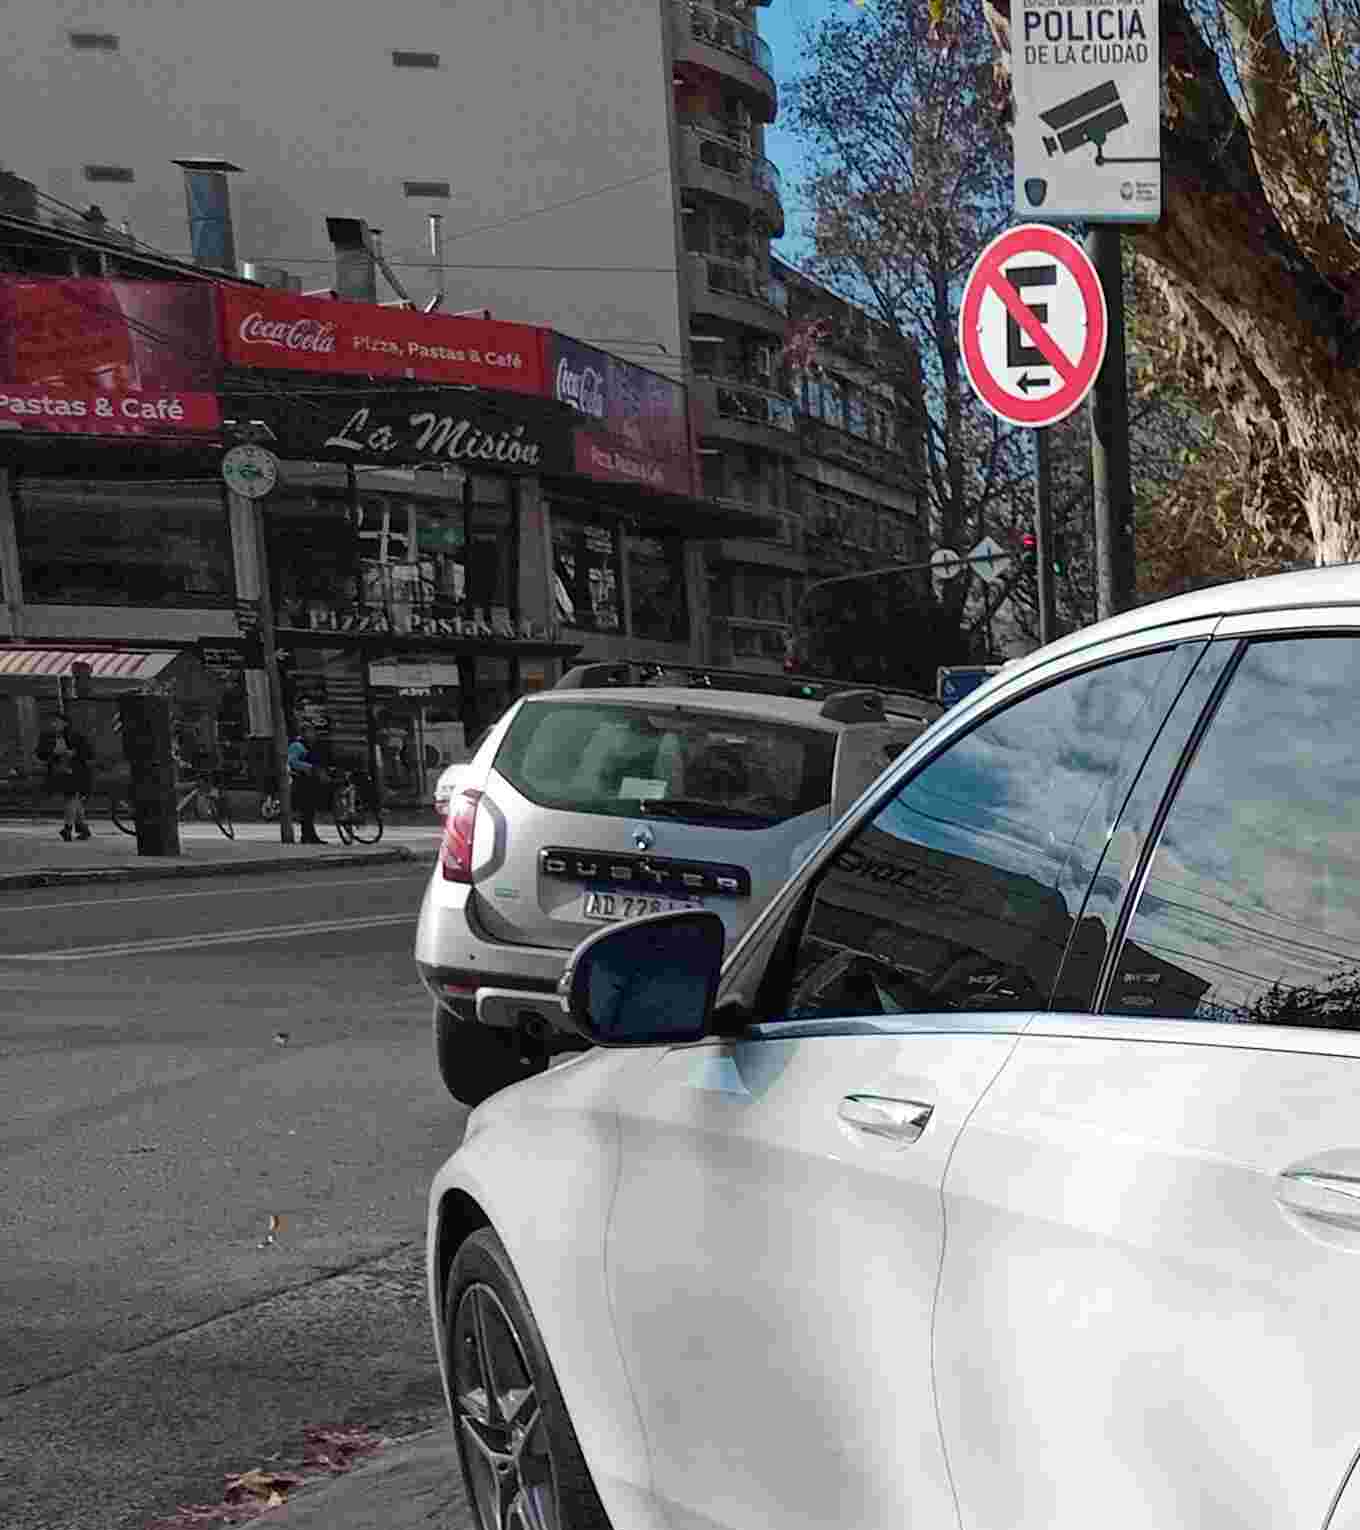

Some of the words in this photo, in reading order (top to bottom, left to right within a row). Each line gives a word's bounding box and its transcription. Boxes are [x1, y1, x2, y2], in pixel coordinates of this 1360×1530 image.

[1024, 9, 1146, 41] POLICIA
[1025, 45, 1048, 64] DE
[1054, 45, 1076, 64] LA
[1081, 44, 1148, 64] CIUDAD
[408, 342, 464, 362] Pastas
[485, 349, 523, 368] Café
[95, 397, 113, 417] &
[121, 398, 184, 420] Café
[324, 407, 398, 451] La
[409, 412, 543, 464] Misión
[406, 612, 492, 638] Pastas
[546, 857, 738, 890] DUSTER
[586, 895, 615, 915] AD
